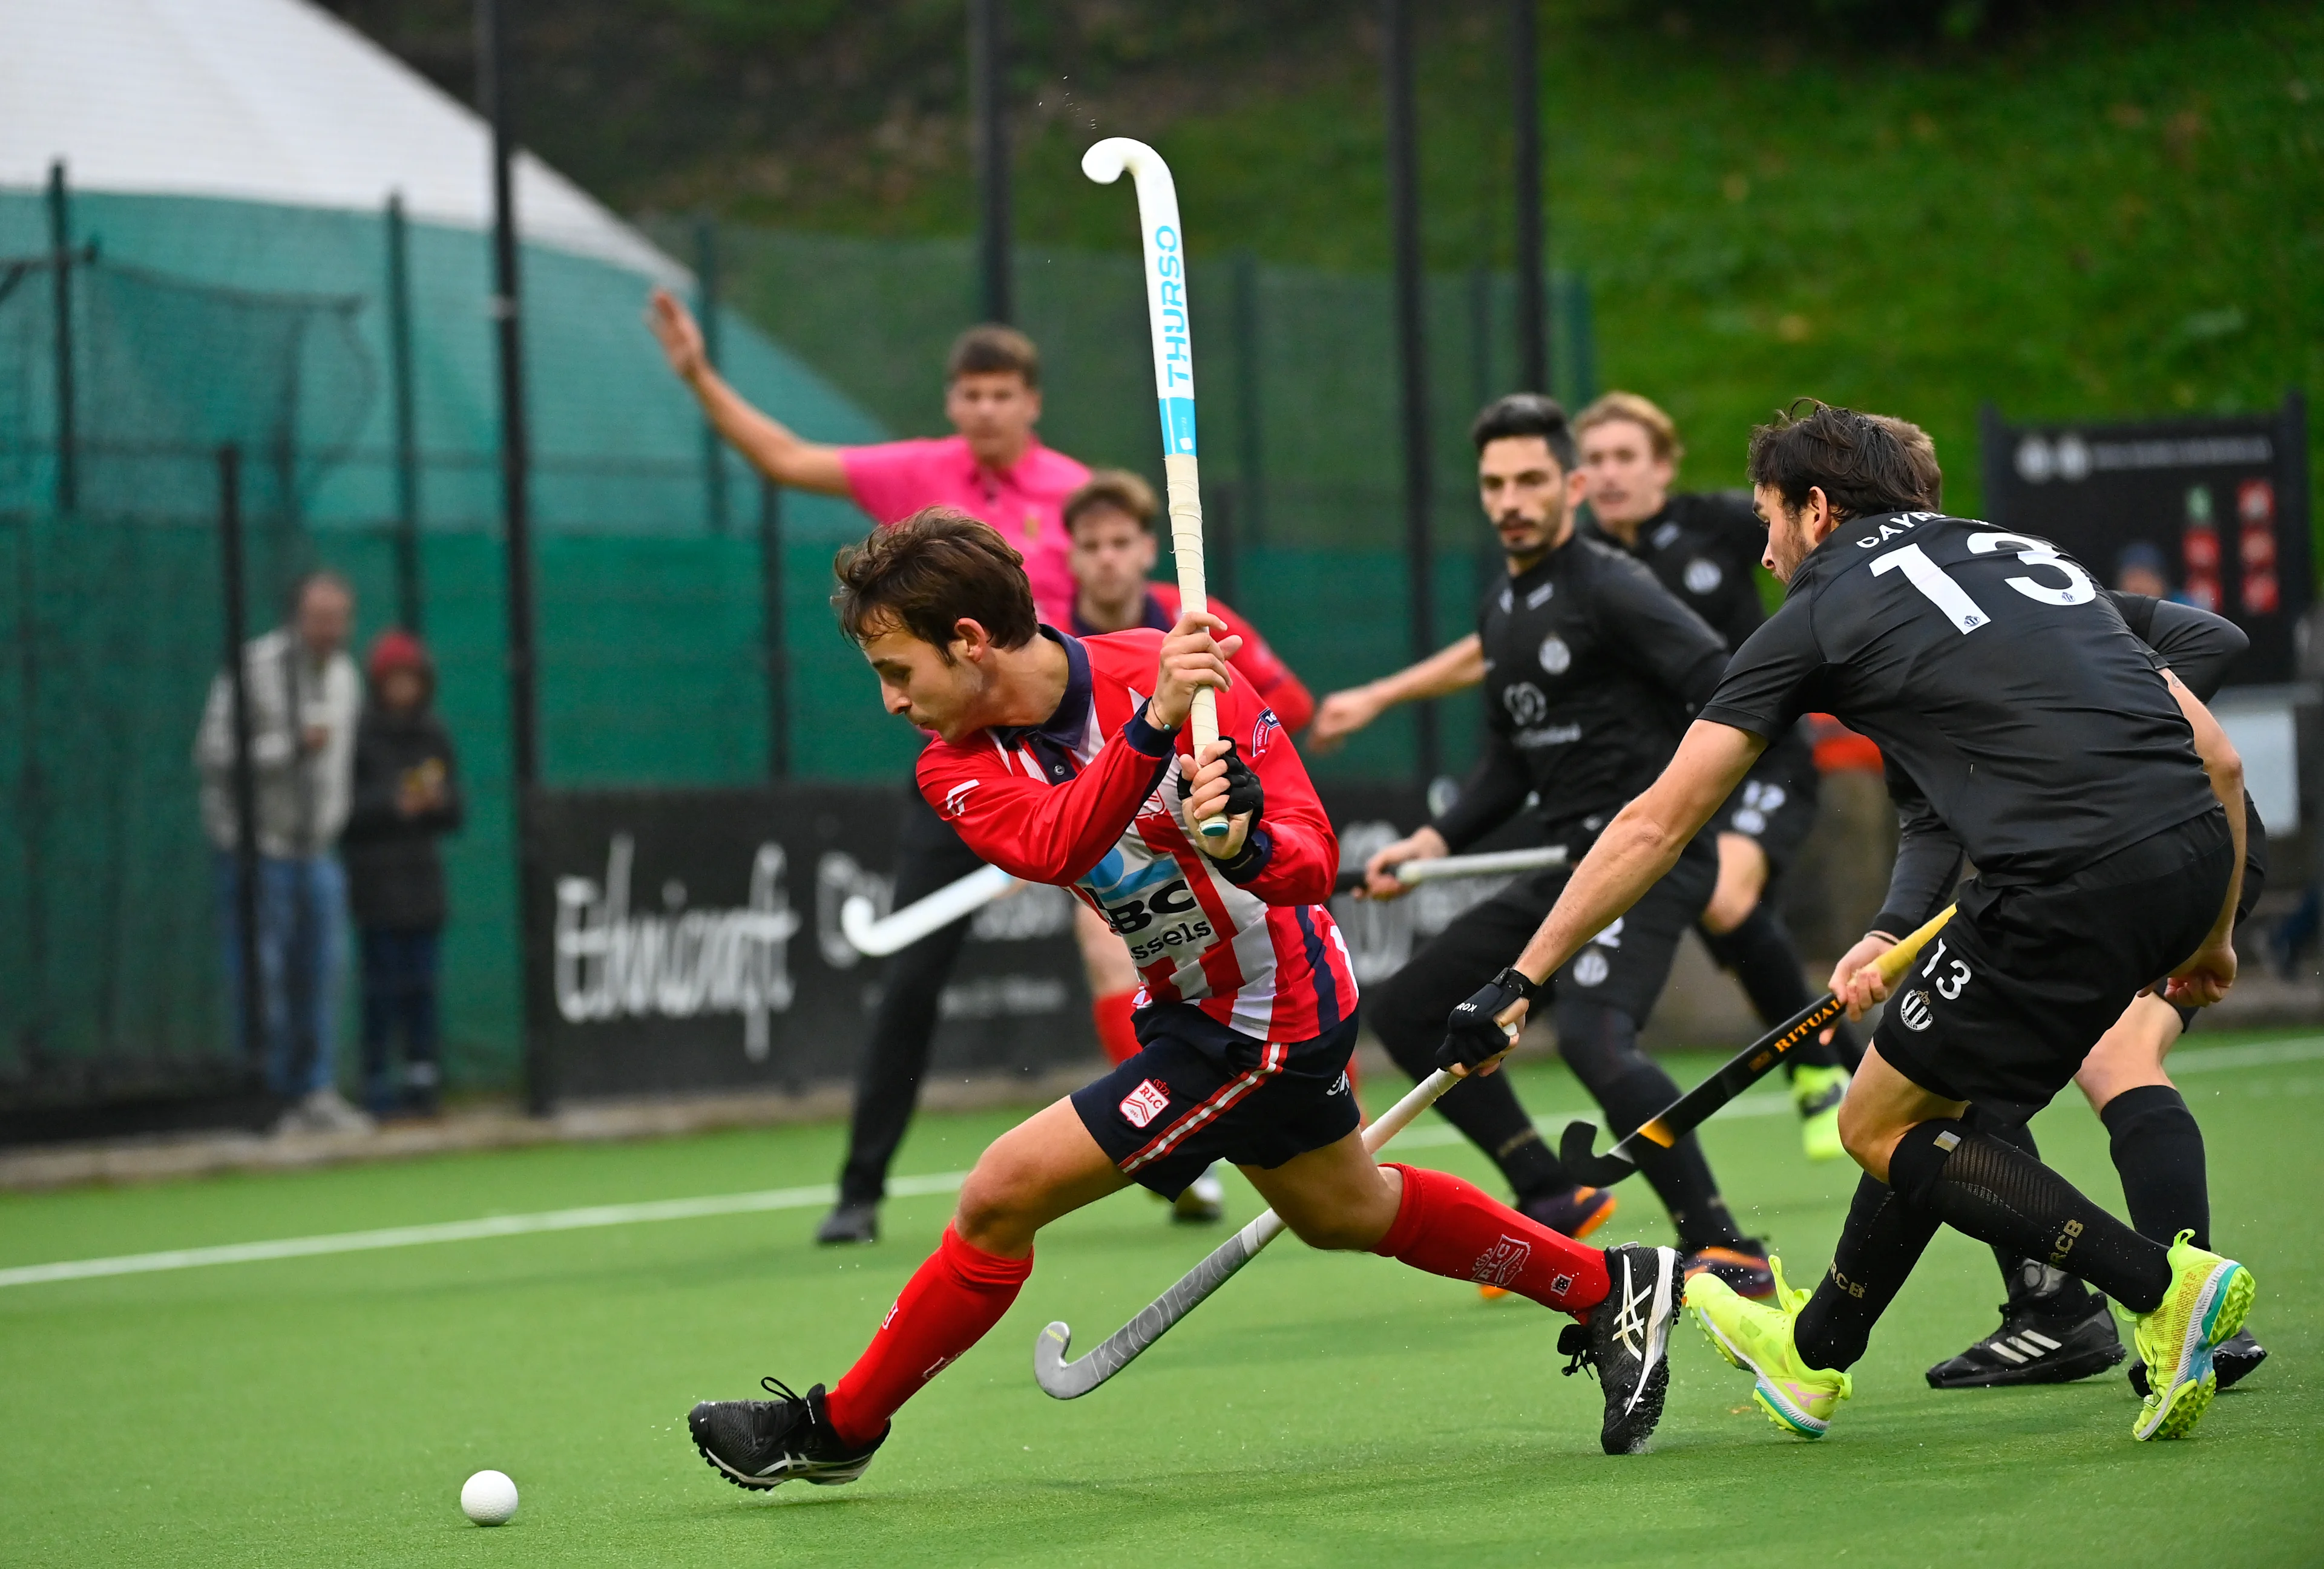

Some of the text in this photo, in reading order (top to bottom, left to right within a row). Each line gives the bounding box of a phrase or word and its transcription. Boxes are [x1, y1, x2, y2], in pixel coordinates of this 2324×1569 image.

[1155, 225, 1190, 388] THURSO
[1868, 531, 2097, 635] 13
[1256, 724, 1266, 747] HOCKEY
[1083, 879, 1197, 935] BC
[1130, 920, 1212, 960] ssels
[1921, 937, 1972, 1000] 13
[1139, 1085, 1163, 1109] RLC
[1477, 1243, 1511, 1280] RLC
